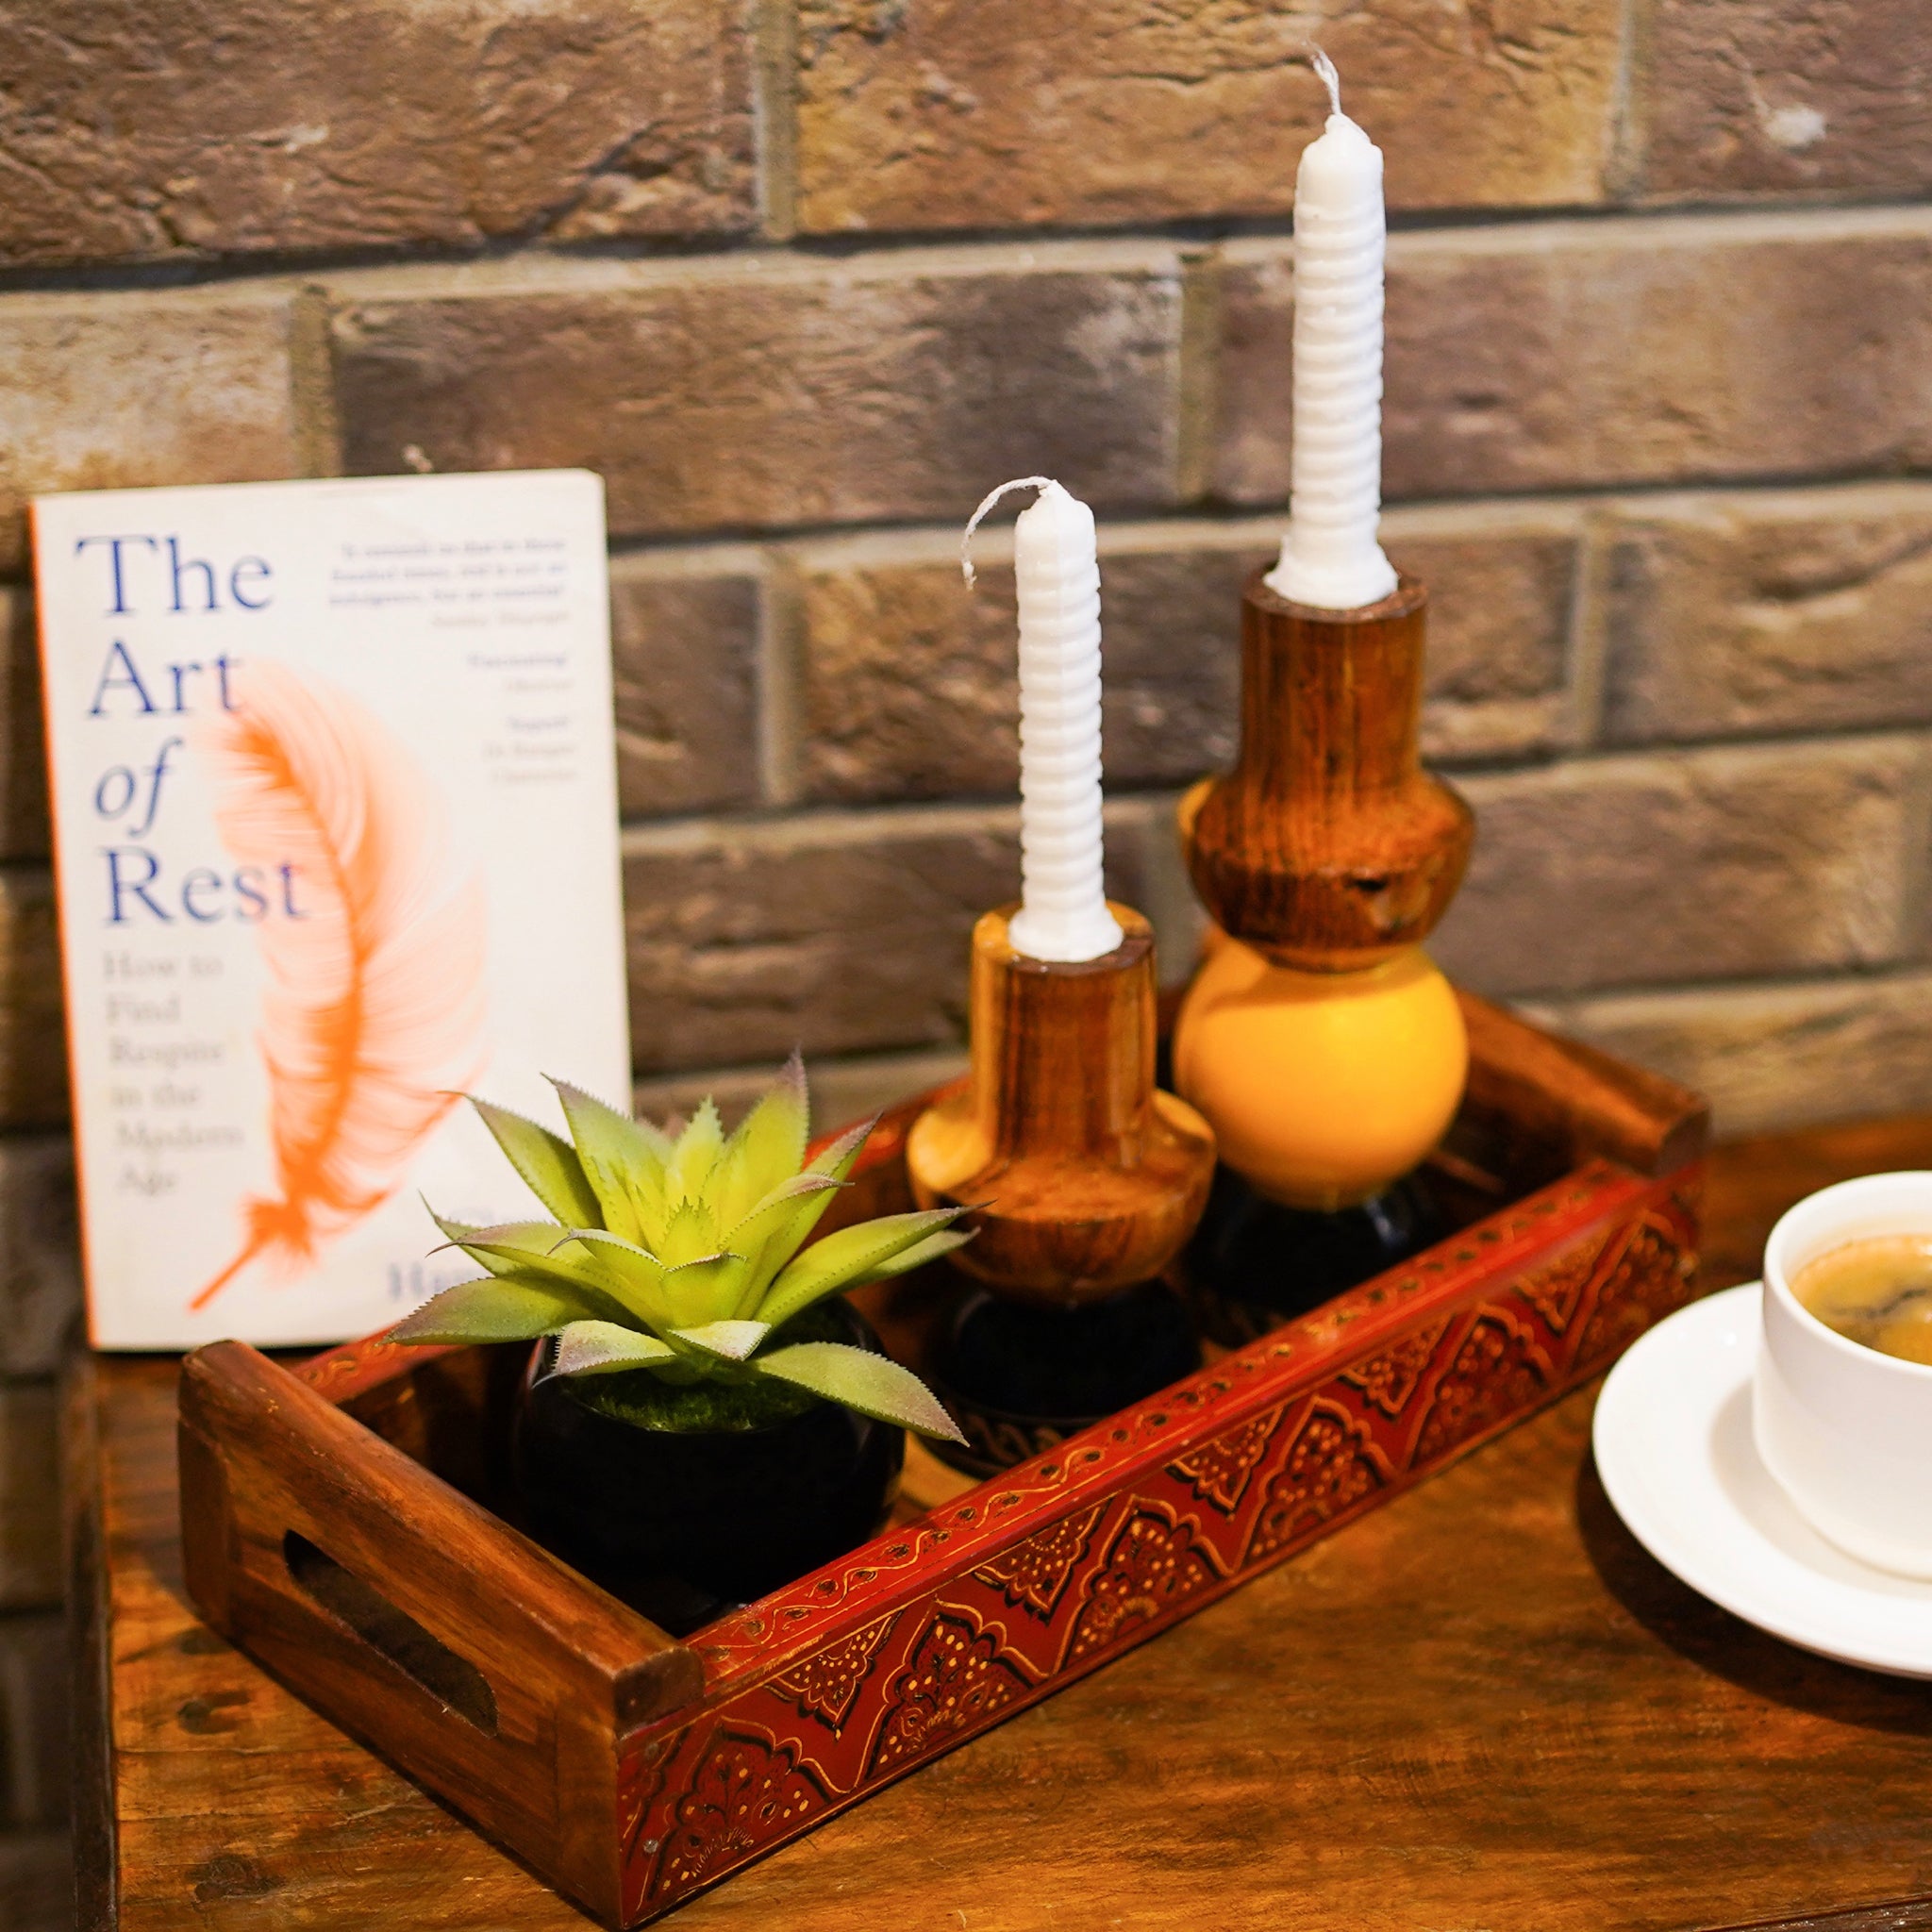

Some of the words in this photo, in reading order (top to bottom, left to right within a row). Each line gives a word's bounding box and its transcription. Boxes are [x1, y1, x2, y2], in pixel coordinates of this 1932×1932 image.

[76, 533, 274, 613] The
[88, 639, 242, 719] Art
[94, 736, 184, 838] of
[100, 846, 308, 926] Rest
[102, 950, 175, 981] How
[188, 954, 225, 978] to
[105, 992, 181, 1025] Find
[115, 1119, 245, 1151] Modern
[117, 1162, 179, 1198] Age
